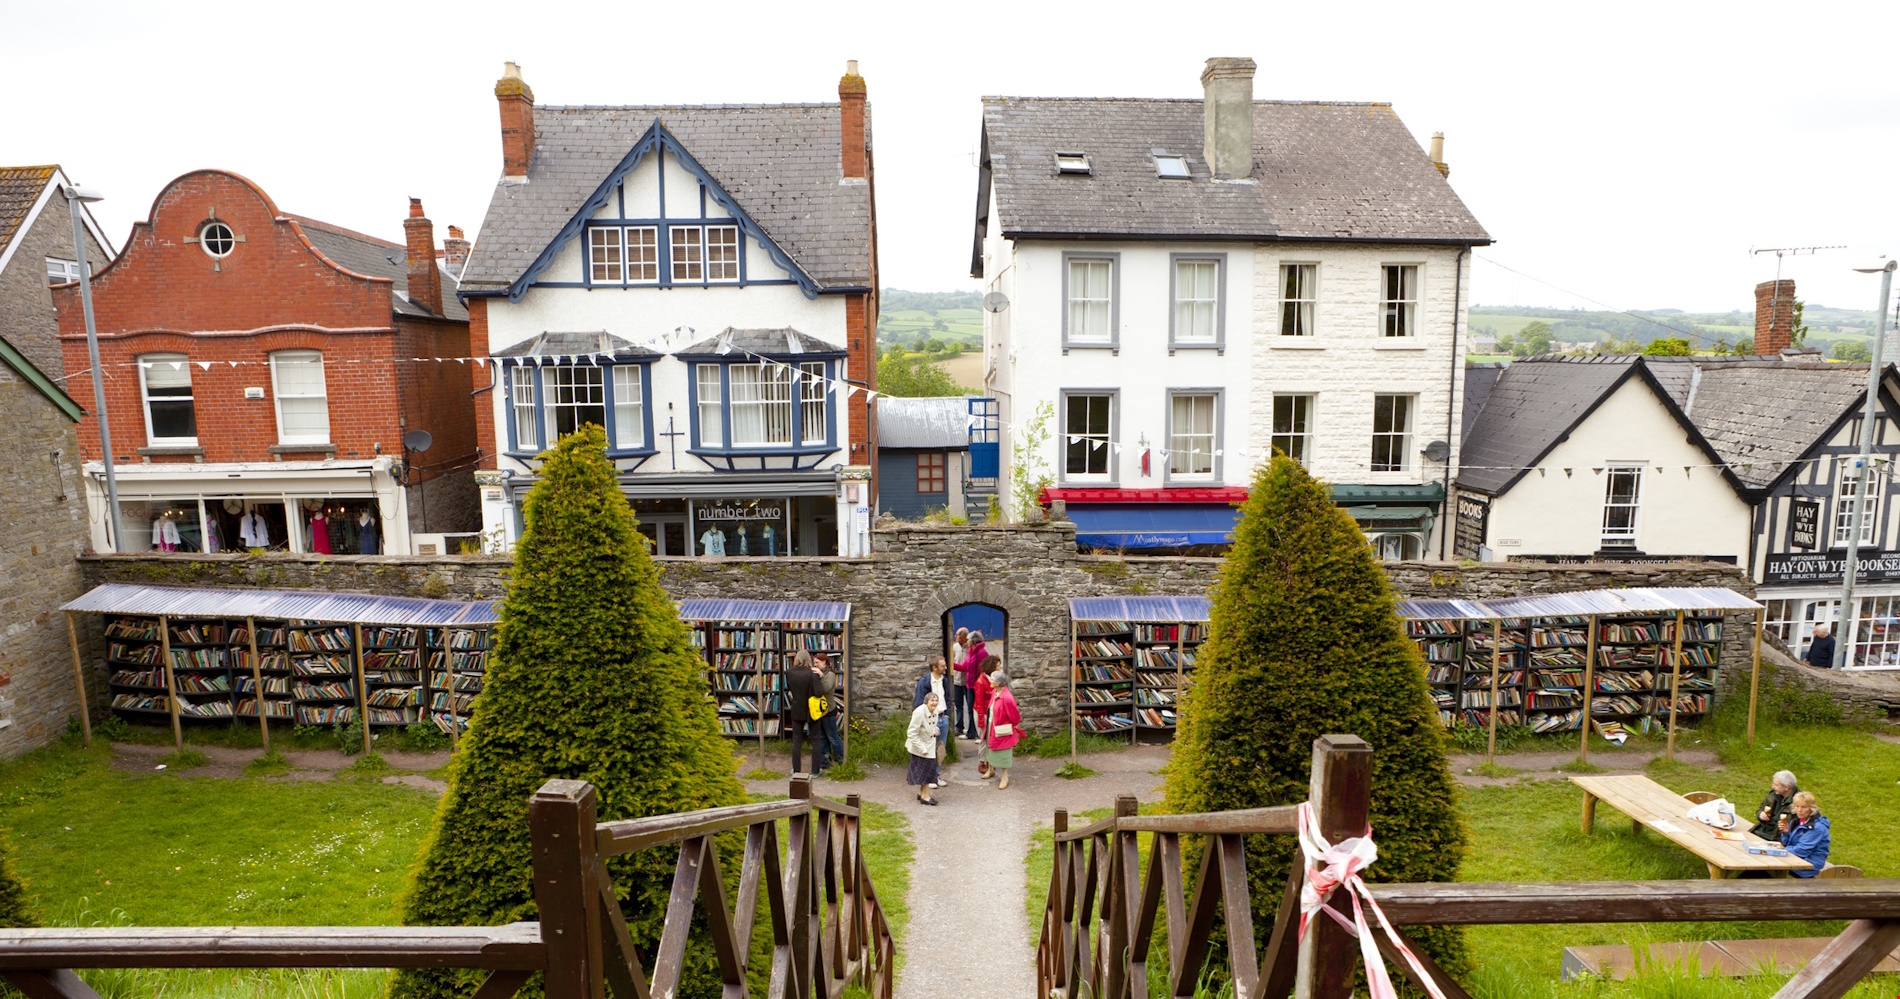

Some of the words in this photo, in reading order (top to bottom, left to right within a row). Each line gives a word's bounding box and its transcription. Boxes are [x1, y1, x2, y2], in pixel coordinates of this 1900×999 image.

[699, 505, 748, 518] number
[755, 505, 781, 518] two
[1459, 500, 1482, 519] BOOKS
[1796, 506, 1815, 518] HAY
[1796, 521, 1814, 532] WYE
[1794, 531, 1814, 544] BOOKS
